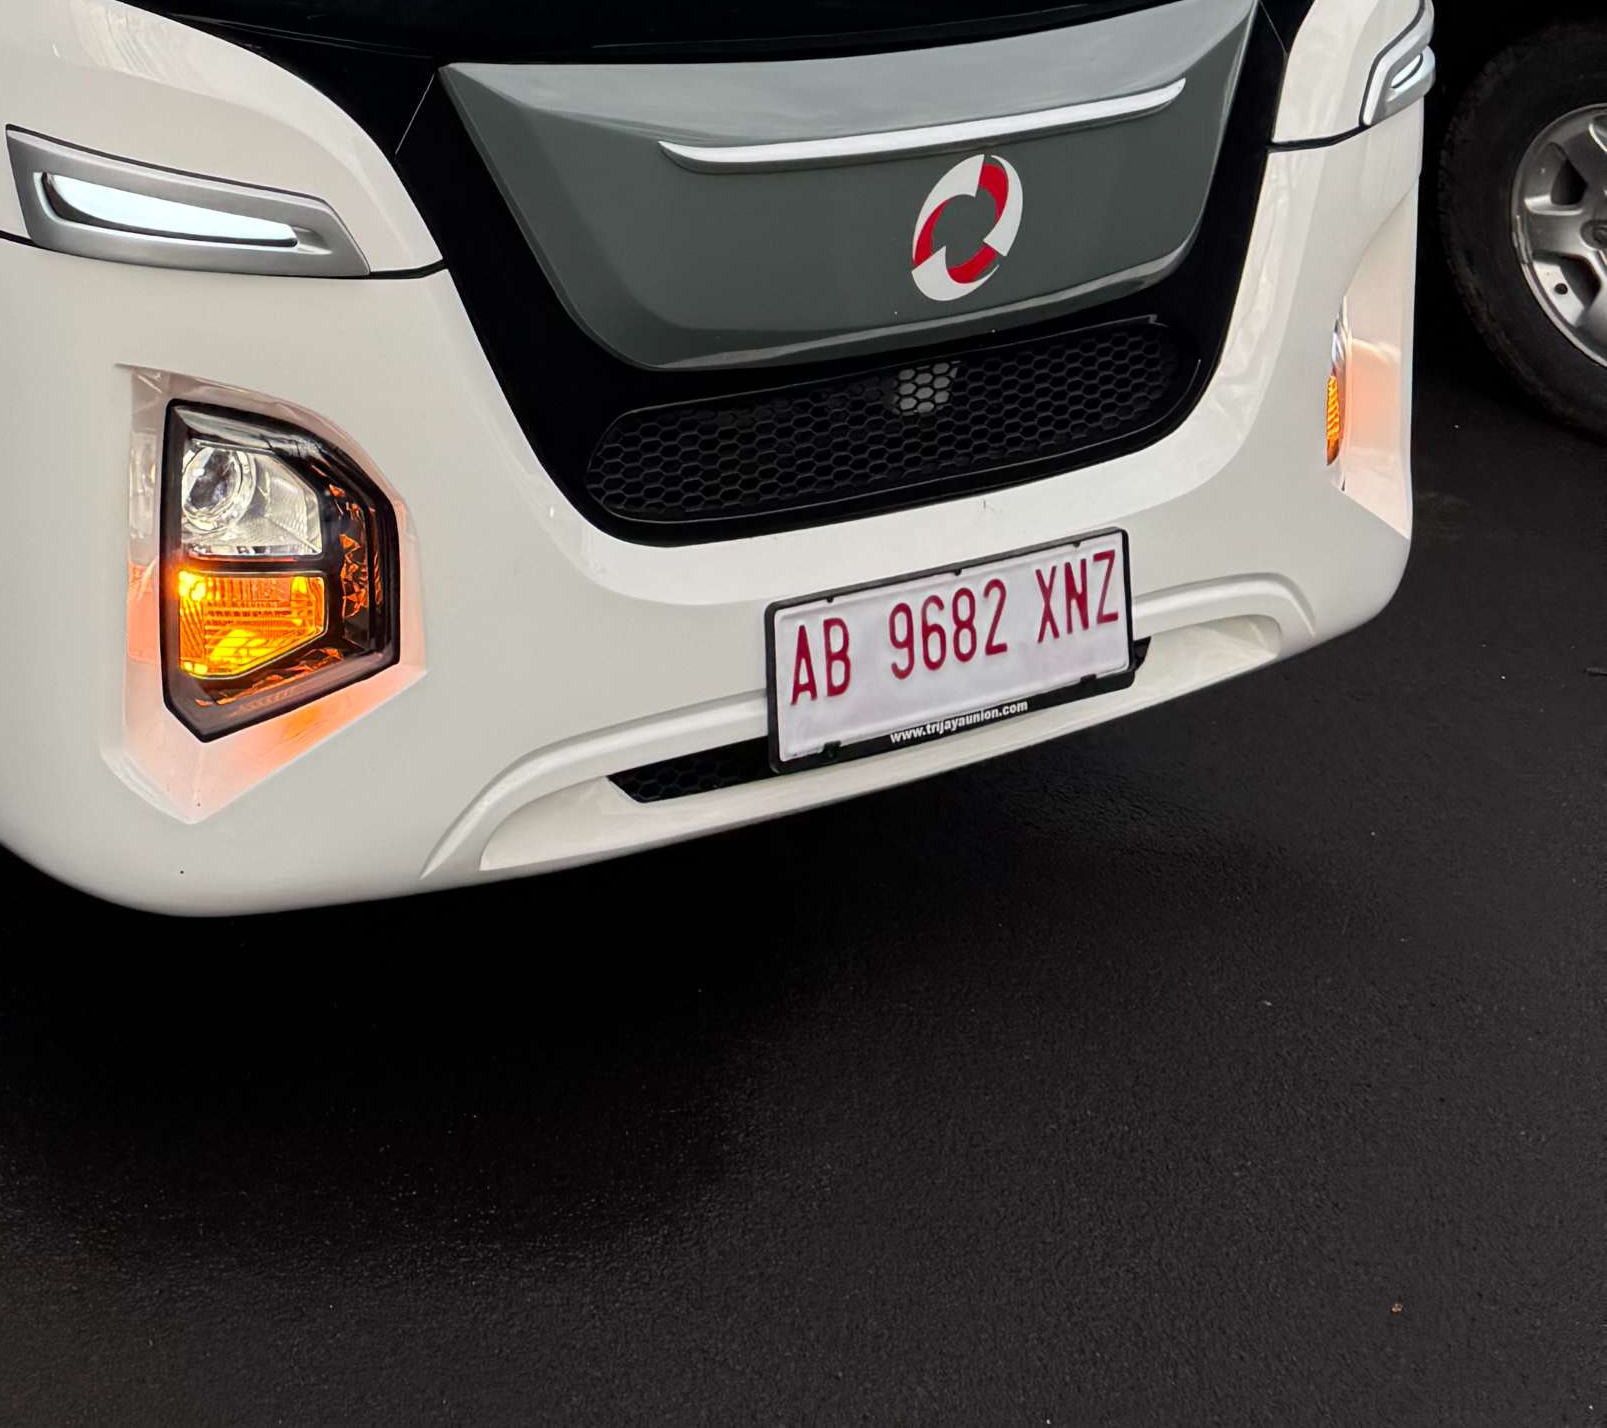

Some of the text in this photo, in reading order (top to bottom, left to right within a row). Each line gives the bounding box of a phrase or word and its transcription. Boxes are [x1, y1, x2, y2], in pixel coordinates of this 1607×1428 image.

[790, 549, 1120, 706] AB 9682 XNZ
[890, 700, 1029, 744] www.trijayaunion.com
